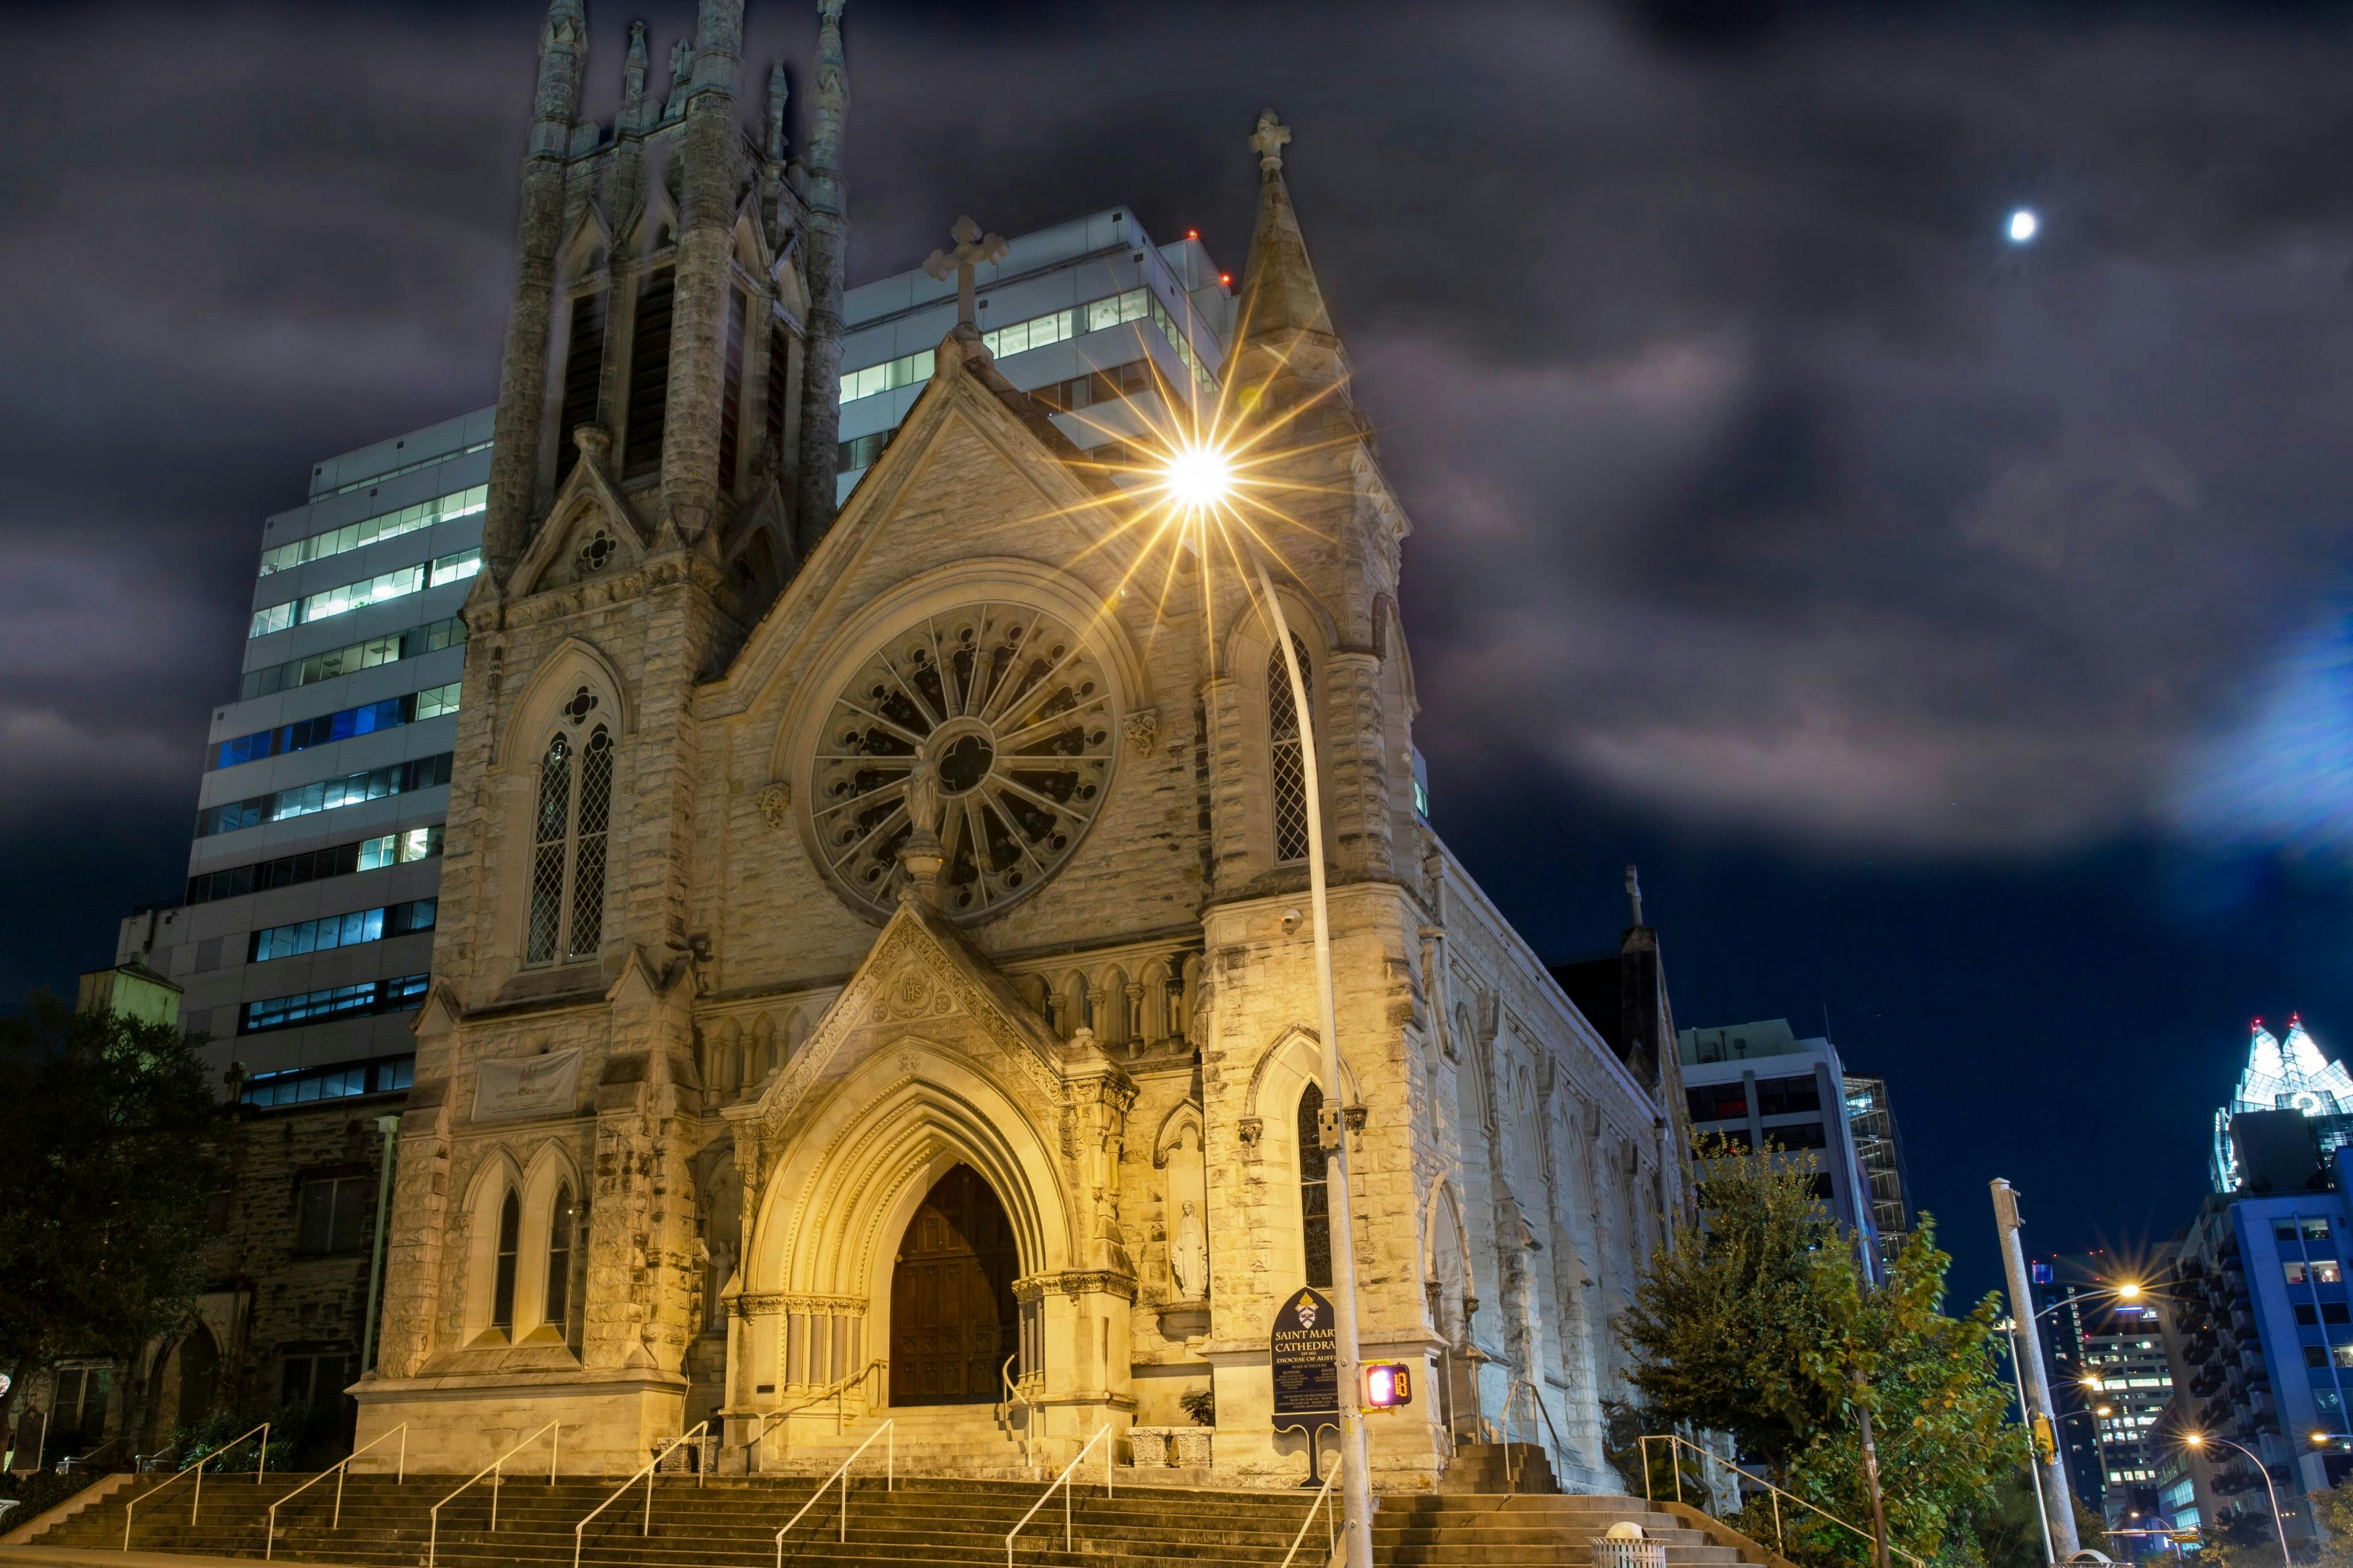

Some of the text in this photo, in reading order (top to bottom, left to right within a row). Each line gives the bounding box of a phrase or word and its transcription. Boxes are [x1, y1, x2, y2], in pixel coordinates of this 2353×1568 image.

[1276, 1328, 1335, 1341] SAINT MAR
[1275, 1341, 1335, 1352] CATHEDRA
